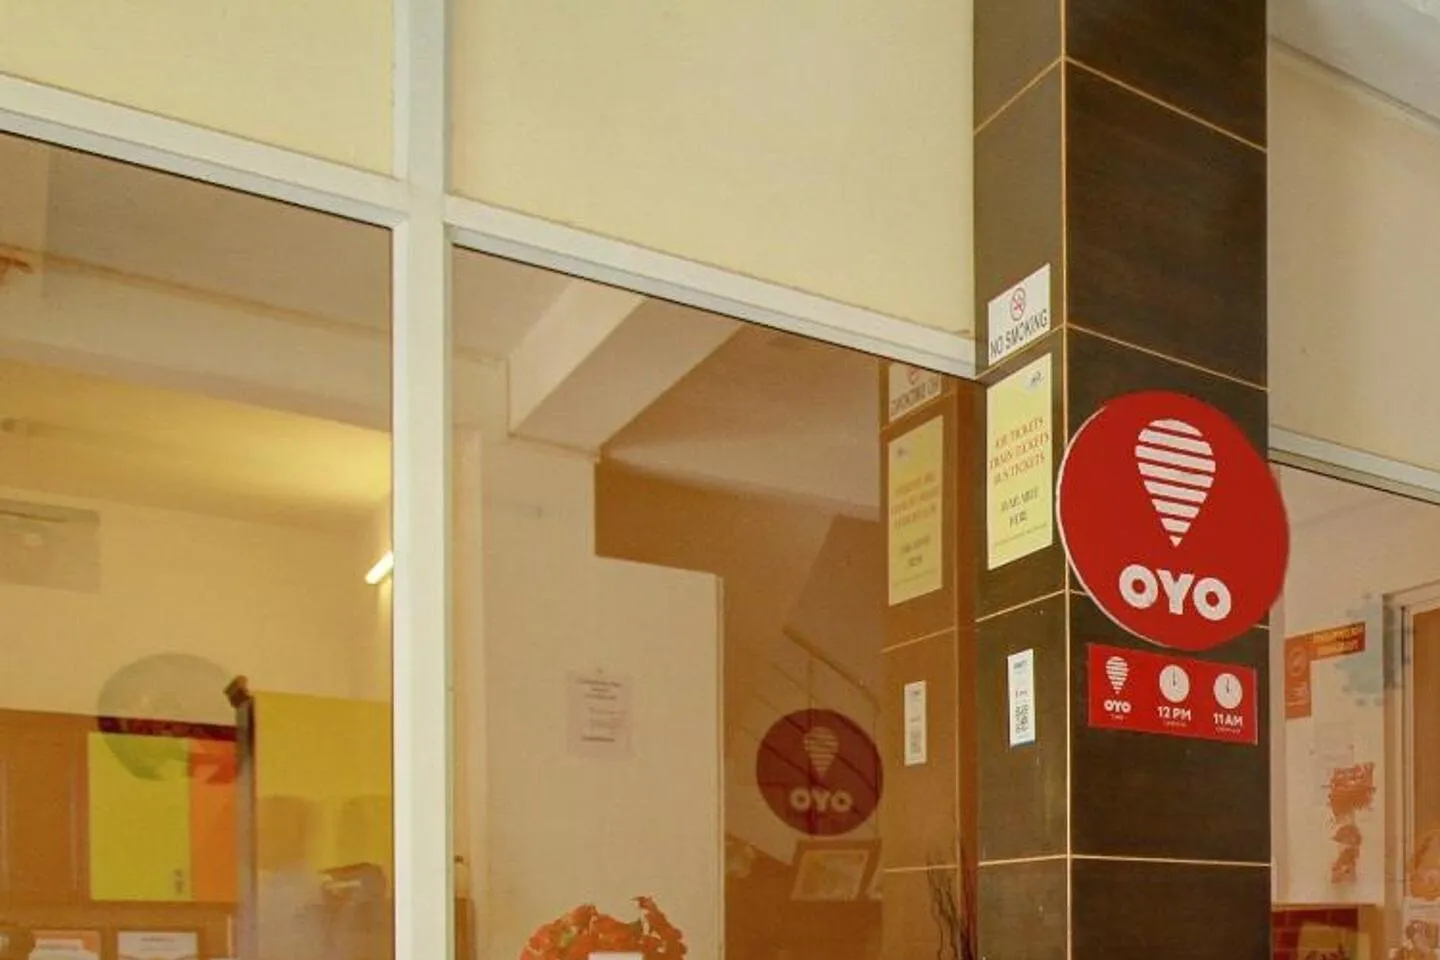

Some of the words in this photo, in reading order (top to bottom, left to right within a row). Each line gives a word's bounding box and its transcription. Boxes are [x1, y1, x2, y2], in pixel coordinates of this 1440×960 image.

[1006, 308, 1048, 350] SMOKING
[1118, 563, 1232, 622] OYO
[1104, 699, 1132, 714] OYO
[1158, 706, 1171, 719] 12
[1172, 708, 1192, 722] PM
